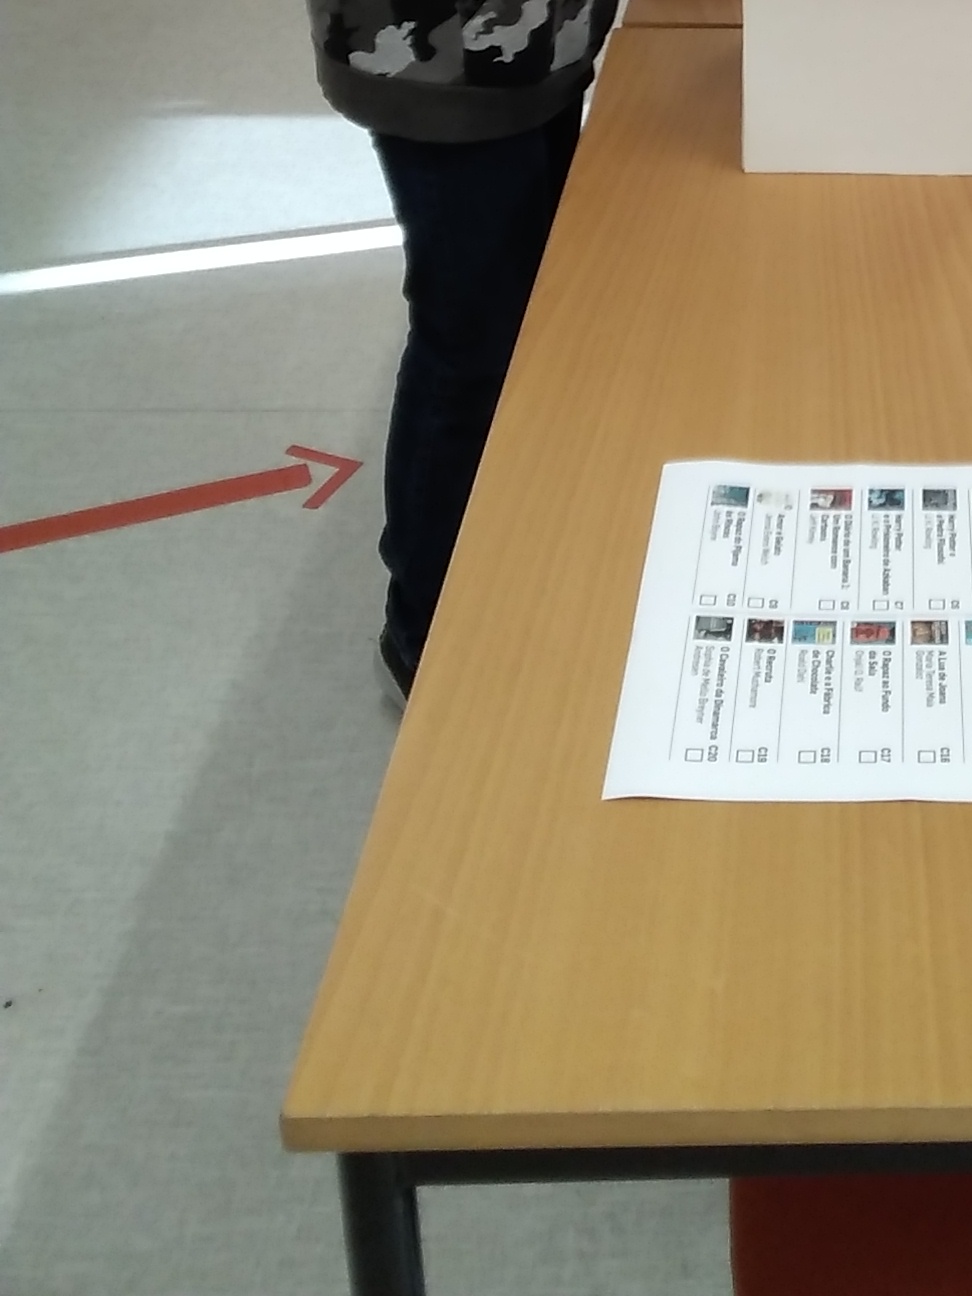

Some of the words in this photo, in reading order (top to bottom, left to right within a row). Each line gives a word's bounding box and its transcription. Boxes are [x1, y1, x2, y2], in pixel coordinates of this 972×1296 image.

[811, 649, 820, 658] de
[868, 650, 877, 659] da
[764, 655, 775, 682] Recruta
[824, 650, 834, 674] Charlie
[868, 661, 877, 676] Sala
[881, 657, 891, 678] Rapaz
[938, 657, 946, 670] Lua
[809, 659, 820, 694] Chocolate
[938, 672, 946, 680] de
[714, 688, 724, 697] da
[938, 682, 947, 704] Joana
[881, 690, 890, 712] Fundo
[707, 745, 718, 761] C20
[757, 747, 767, 762] C19
[820, 747, 830, 762] C18
[881, 748, 890, 762] C17
[940, 747, 949, 762] C16
